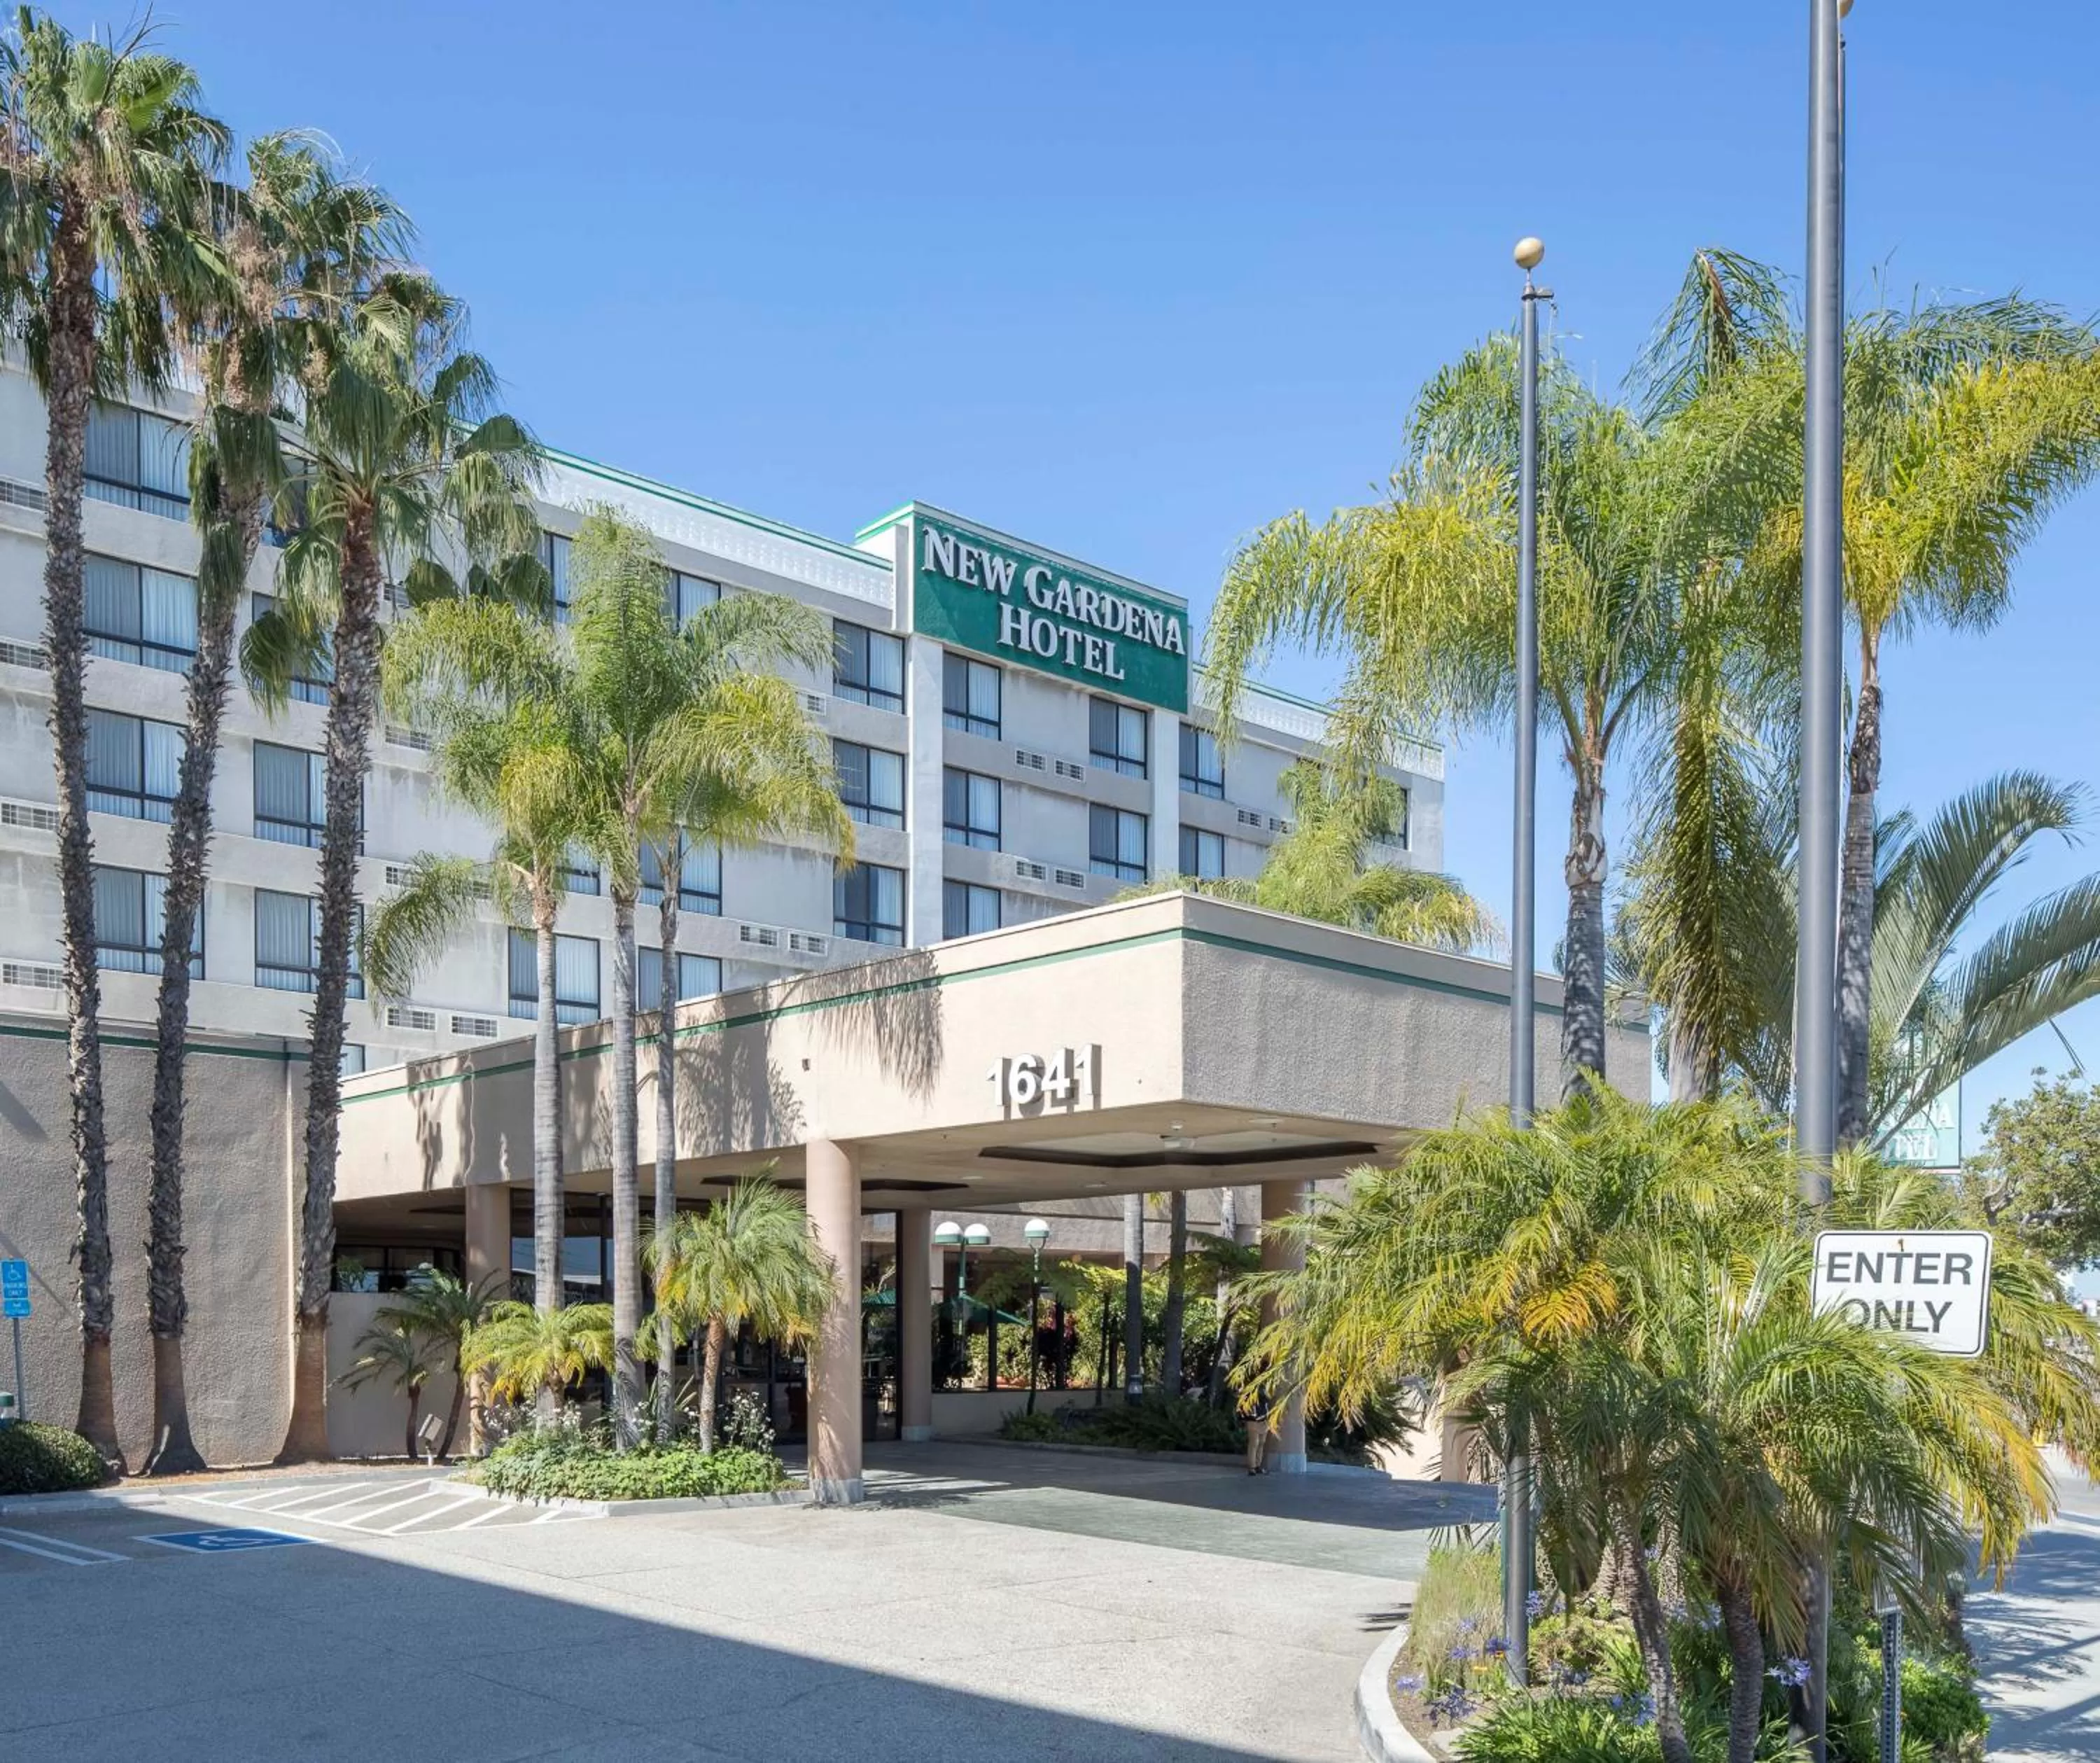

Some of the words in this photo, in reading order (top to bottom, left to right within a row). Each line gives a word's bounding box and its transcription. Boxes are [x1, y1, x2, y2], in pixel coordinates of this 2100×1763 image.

[921, 524, 1018, 597] NEW
[1024, 565, 1186, 655] GARDENA
[997, 601, 1126, 680] HOTEL
[986, 1043, 1101, 1106] 1641
[1826, 1251, 1974, 1285] ENTER
[1841, 1298, 1953, 1334] ONLY
